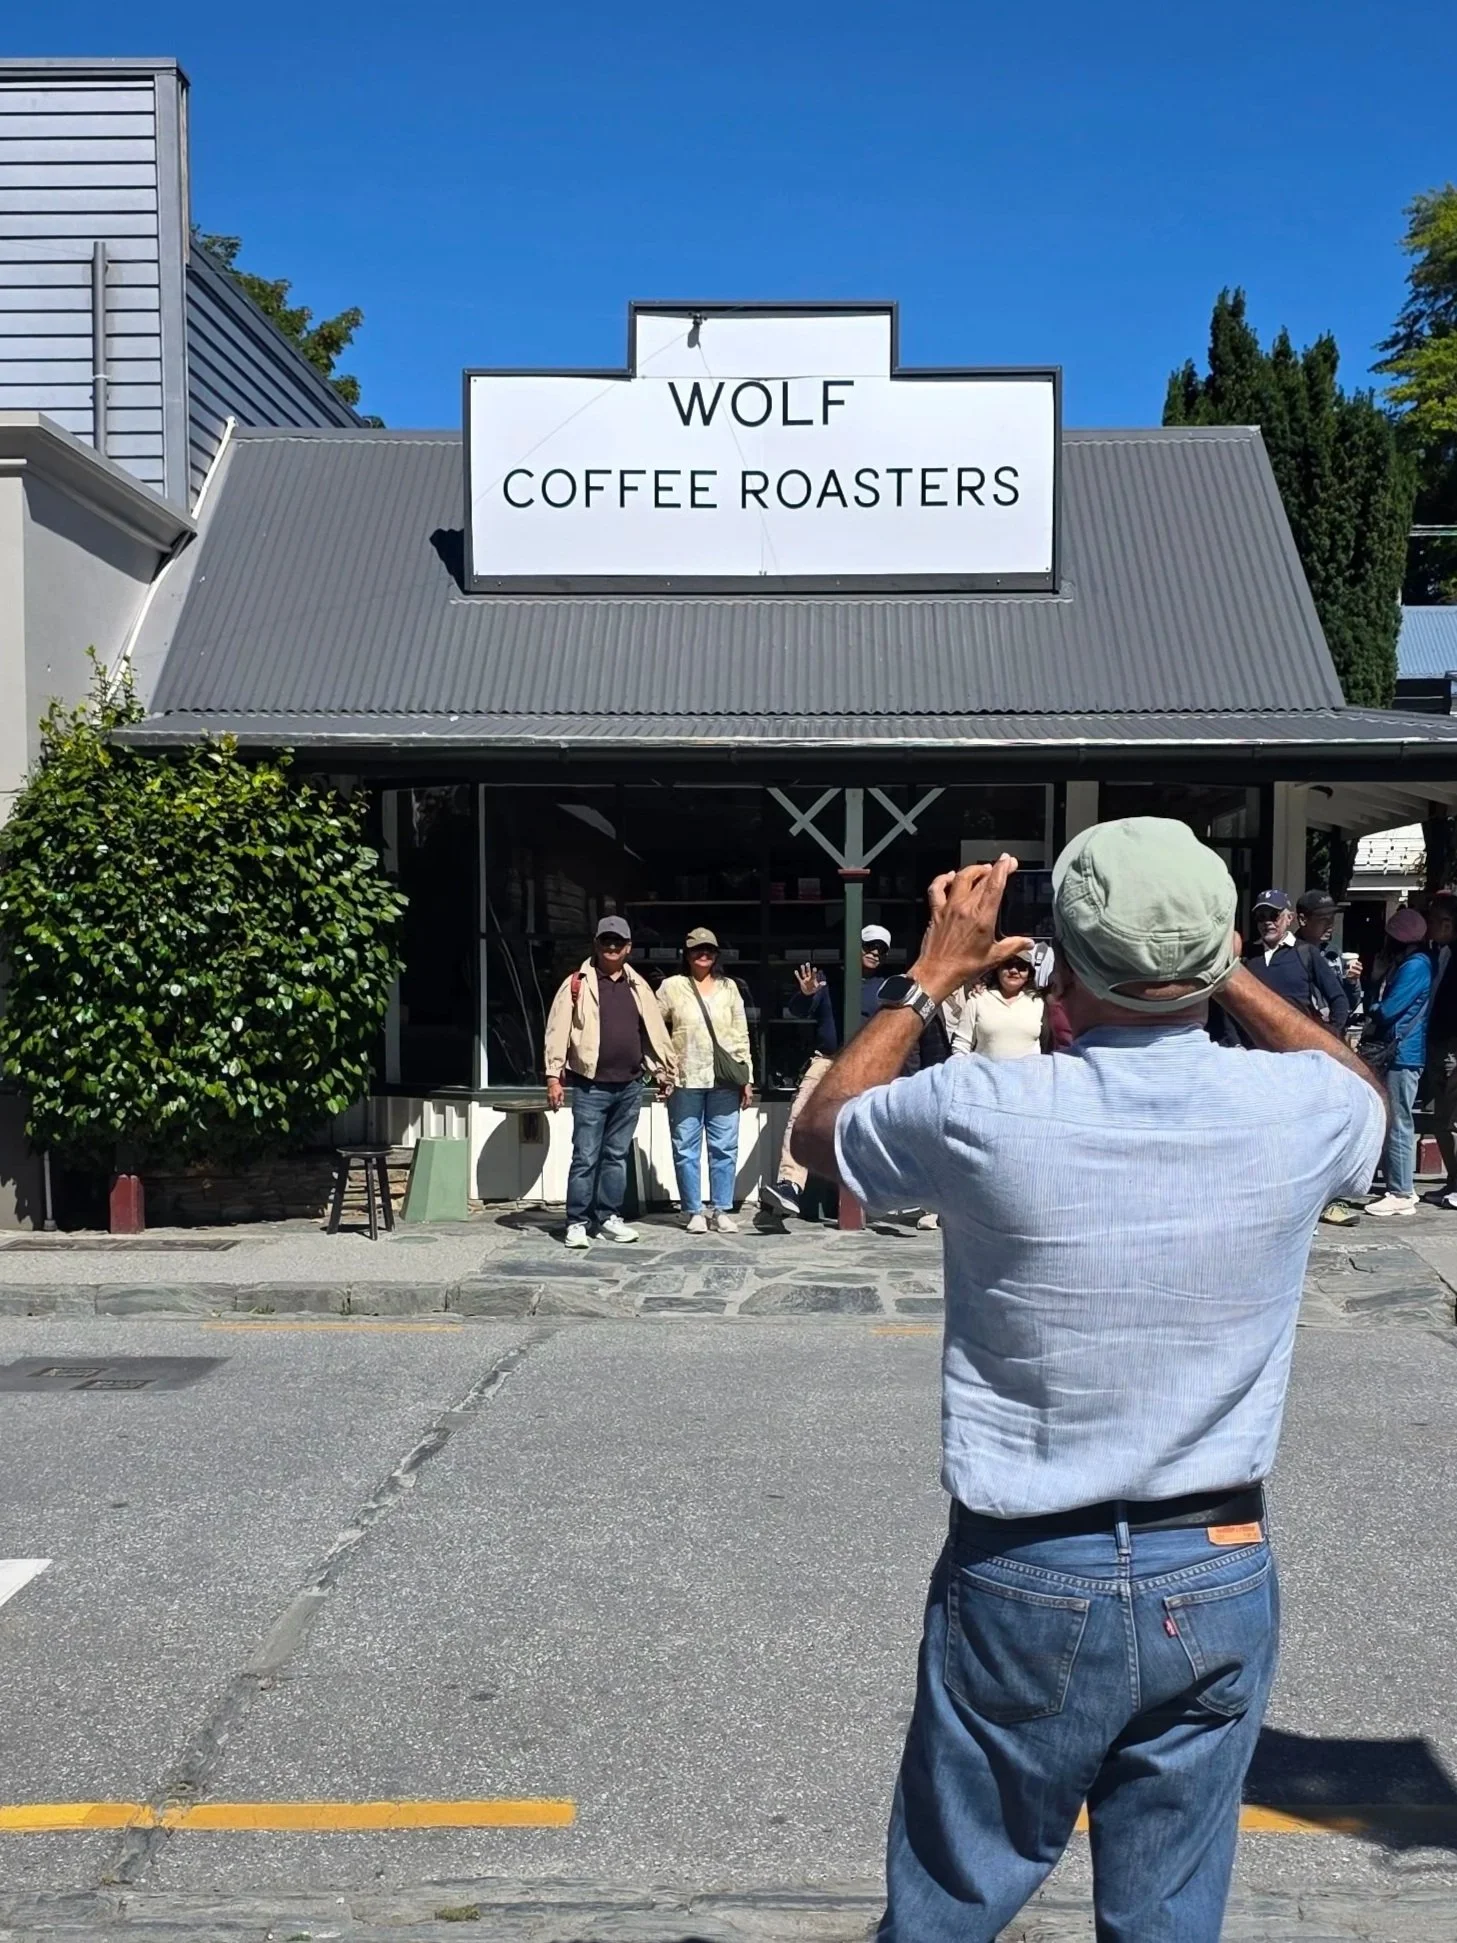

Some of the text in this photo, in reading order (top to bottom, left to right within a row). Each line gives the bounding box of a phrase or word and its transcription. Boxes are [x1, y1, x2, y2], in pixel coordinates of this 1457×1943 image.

[667, 380, 855, 428] WOLF
[502, 465, 1020, 510] COFFEE ROASTERS
